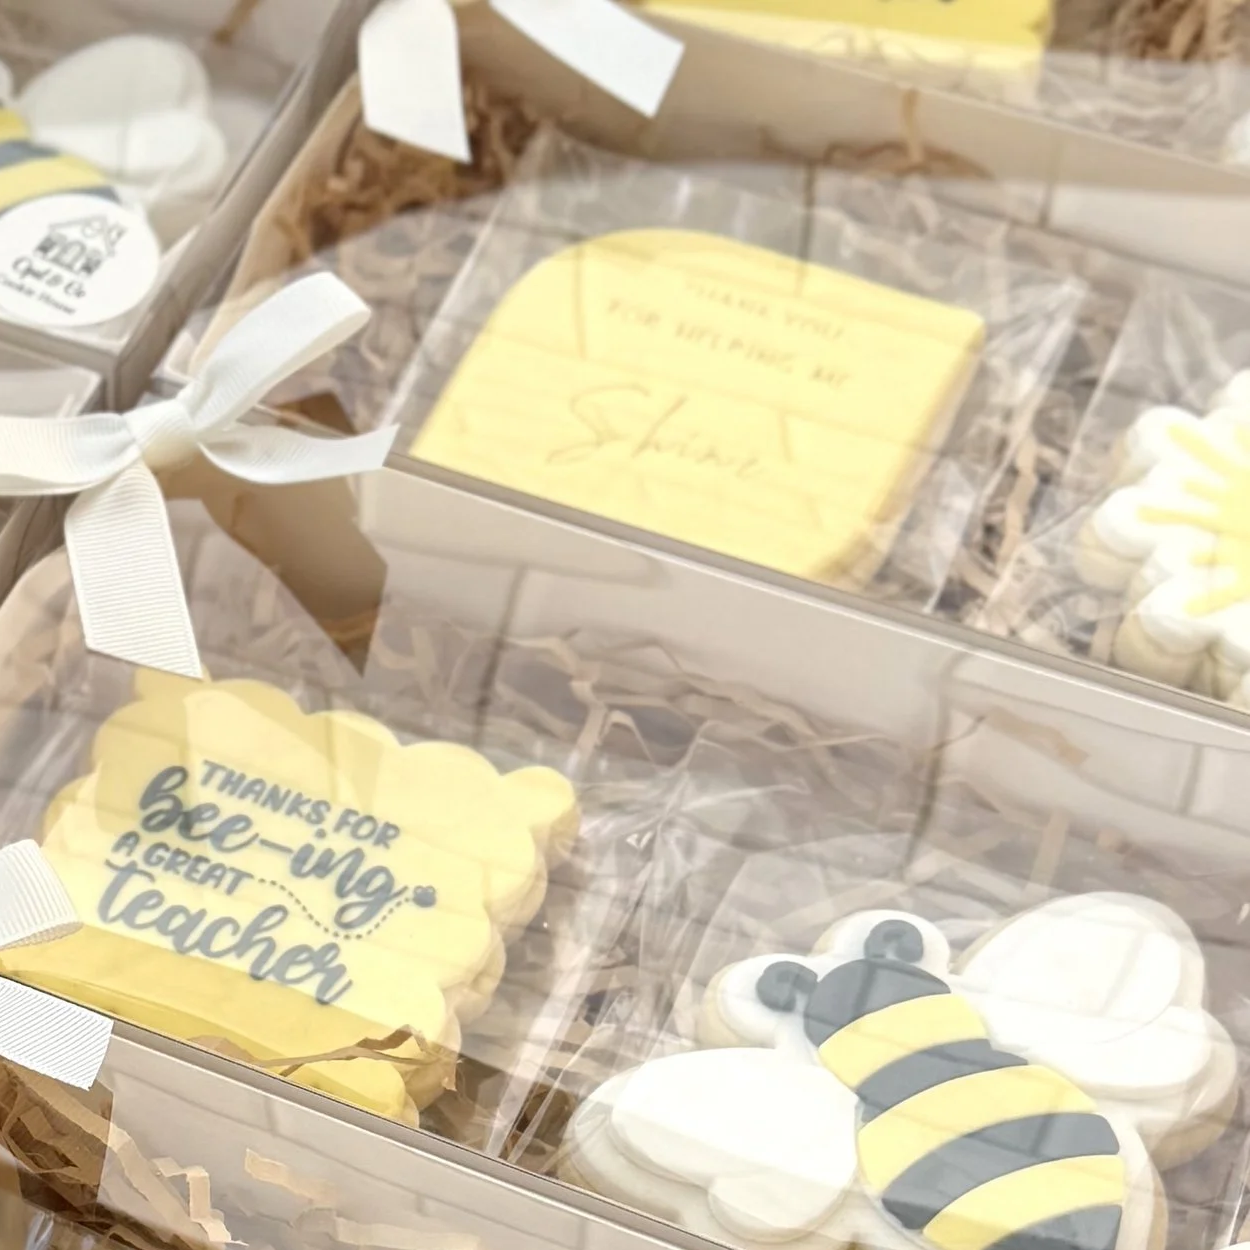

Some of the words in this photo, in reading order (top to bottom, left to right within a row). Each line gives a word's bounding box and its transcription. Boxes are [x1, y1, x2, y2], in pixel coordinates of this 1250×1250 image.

[547, 383, 761, 476] Shine
[139, 765, 409, 931] bee-ing
[199, 759, 331, 825] THANKS
[333, 808, 401, 849] FOR
[111, 830, 140, 857] A
[142, 841, 255, 896] GREAT
[98, 859, 353, 1006] teacher
